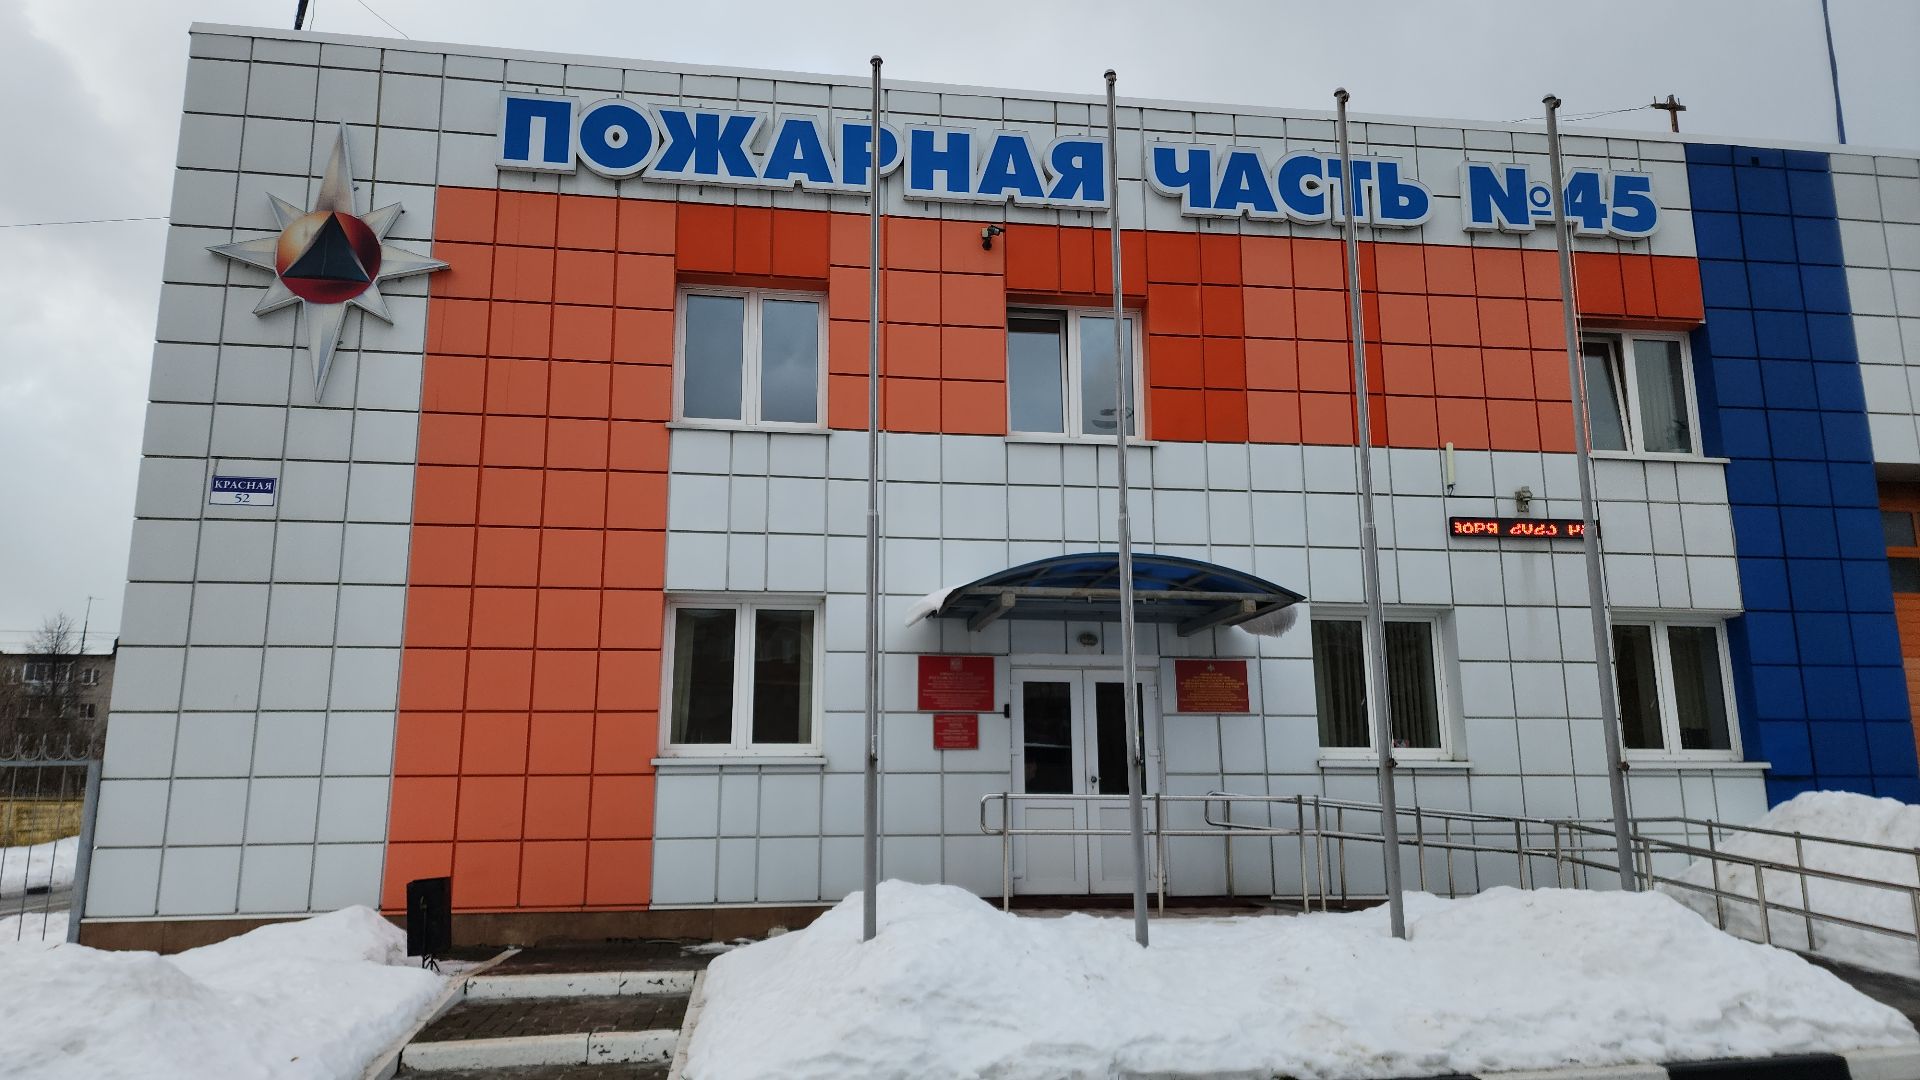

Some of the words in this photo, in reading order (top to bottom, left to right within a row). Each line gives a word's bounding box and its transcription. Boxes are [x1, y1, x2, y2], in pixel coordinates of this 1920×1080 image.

[504, 99, 1104, 201] ПОЖАРНАЯ
[1154, 148, 1428, 219] ЧАСТЬ
[214, 480, 272, 491] КРАСНАЯ
[234, 493, 250, 503] 52
